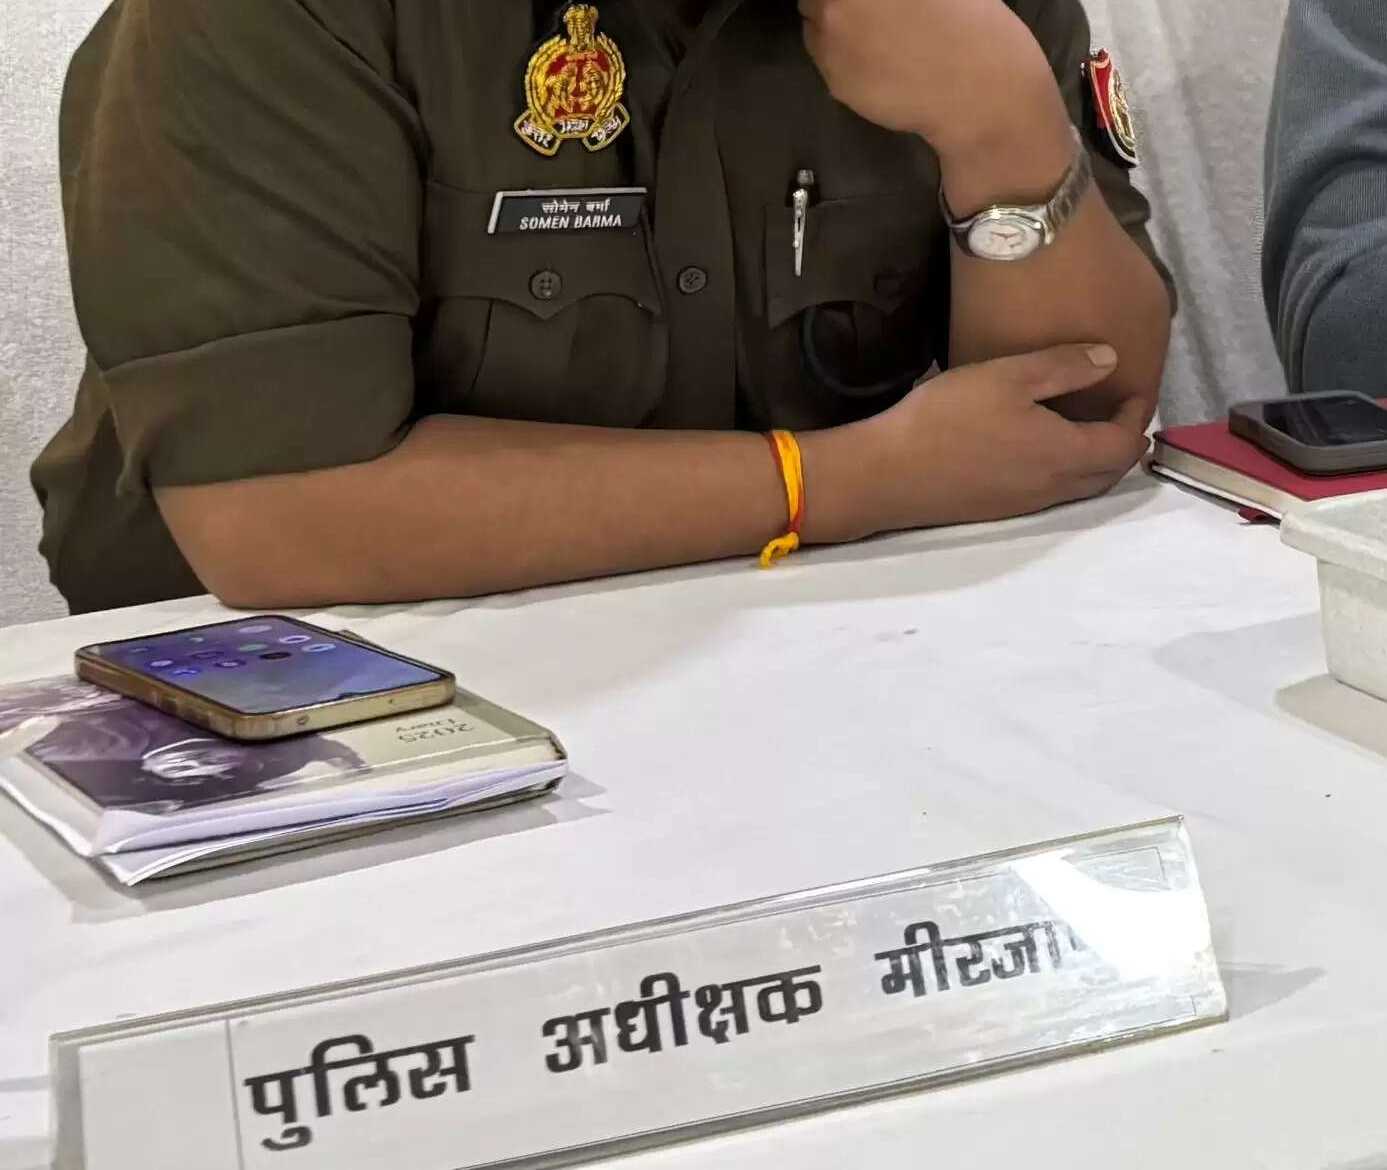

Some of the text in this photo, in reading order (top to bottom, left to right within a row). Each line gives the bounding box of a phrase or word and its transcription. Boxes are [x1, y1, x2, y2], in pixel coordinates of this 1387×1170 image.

[519, 214, 622, 230] SOMEN BARMA
[243, 920, 1076, 1152] पुलिस अधीक्षक मीरजा
